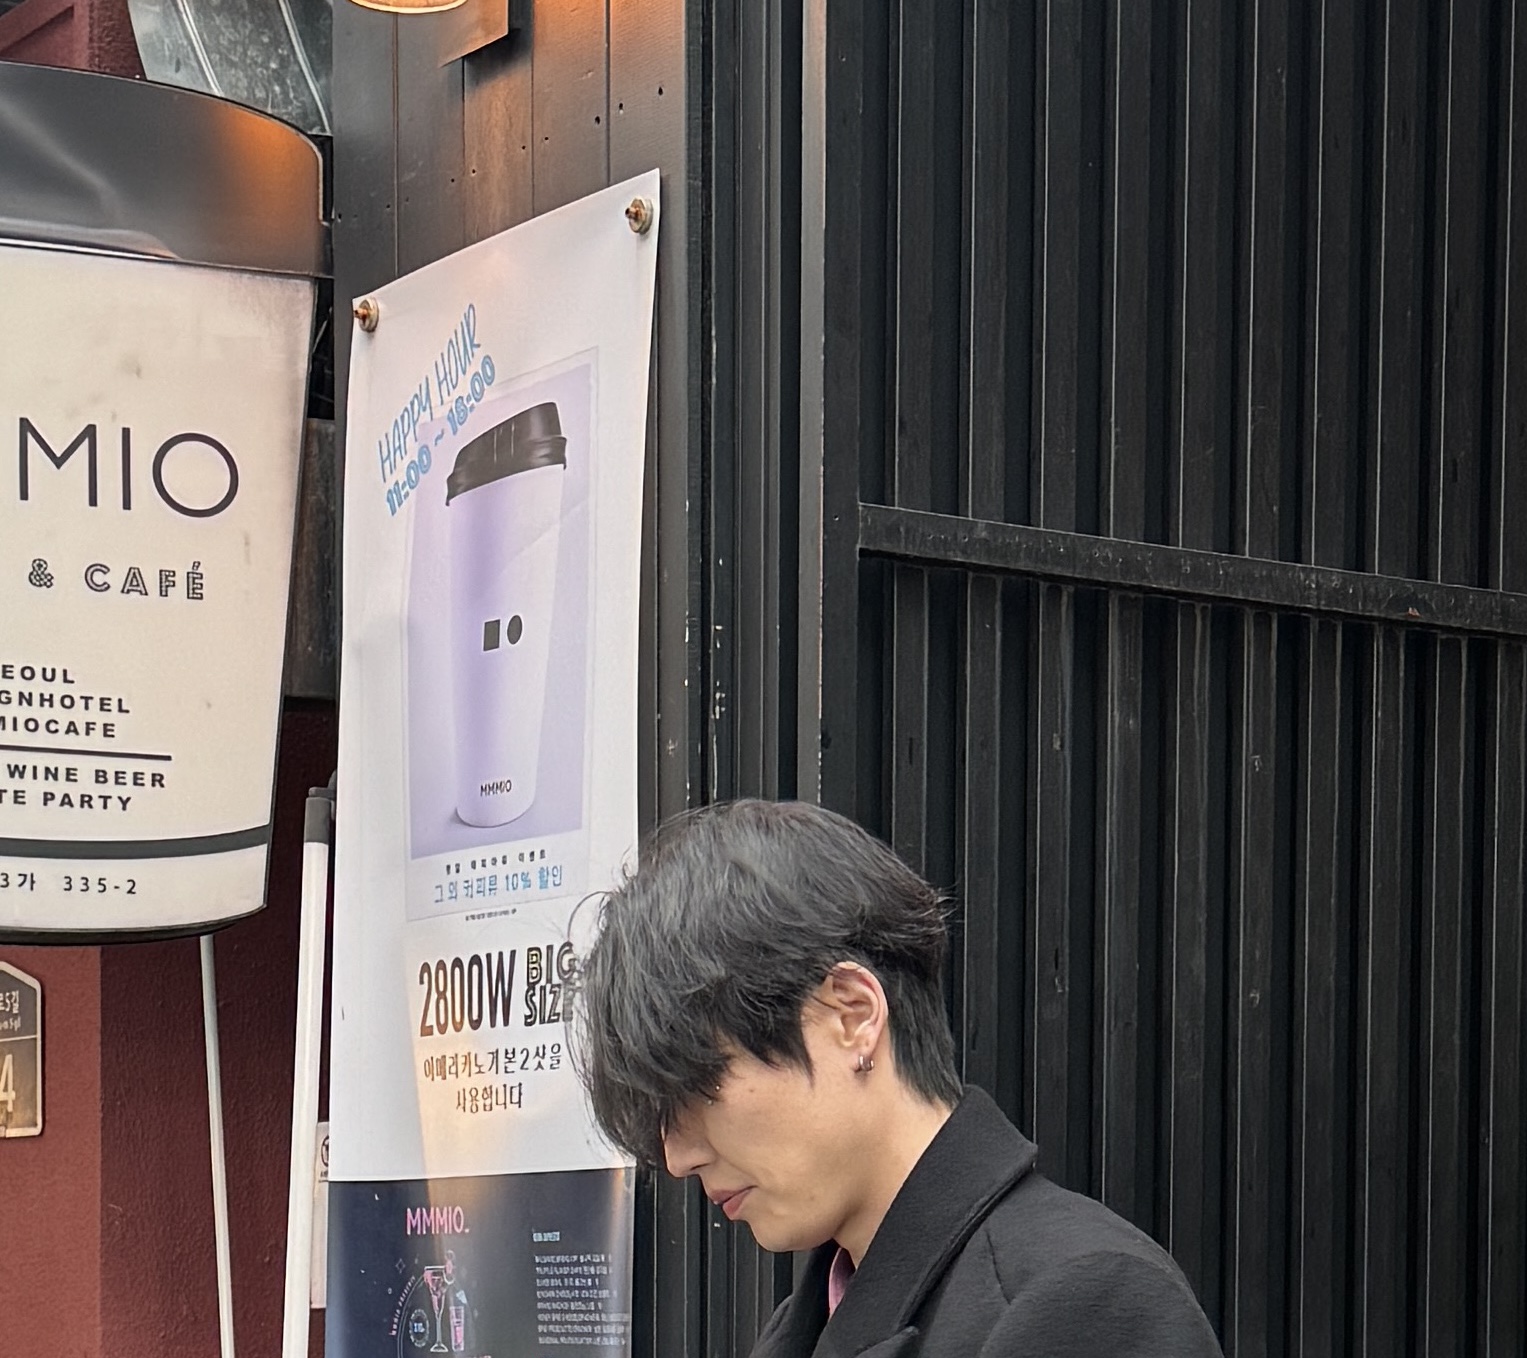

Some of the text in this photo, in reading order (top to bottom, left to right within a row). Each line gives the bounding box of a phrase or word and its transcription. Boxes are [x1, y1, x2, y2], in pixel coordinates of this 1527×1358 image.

[378, 303, 480, 483] HAPPY HOUR
[386, 444, 432, 516] 11:00
[447, 354, 495, 436] 18:00
[19, 417, 239, 518] MIO
[28, 558, 204, 601] & CAFÉ
[1, 664, 76, 685] EOUL
[7, 763, 165, 788] WINE BEER
[42, 791, 132, 811] PARTY
[63, 875, 137, 895] 335-2
[419, 949, 517, 1038] 2800W
